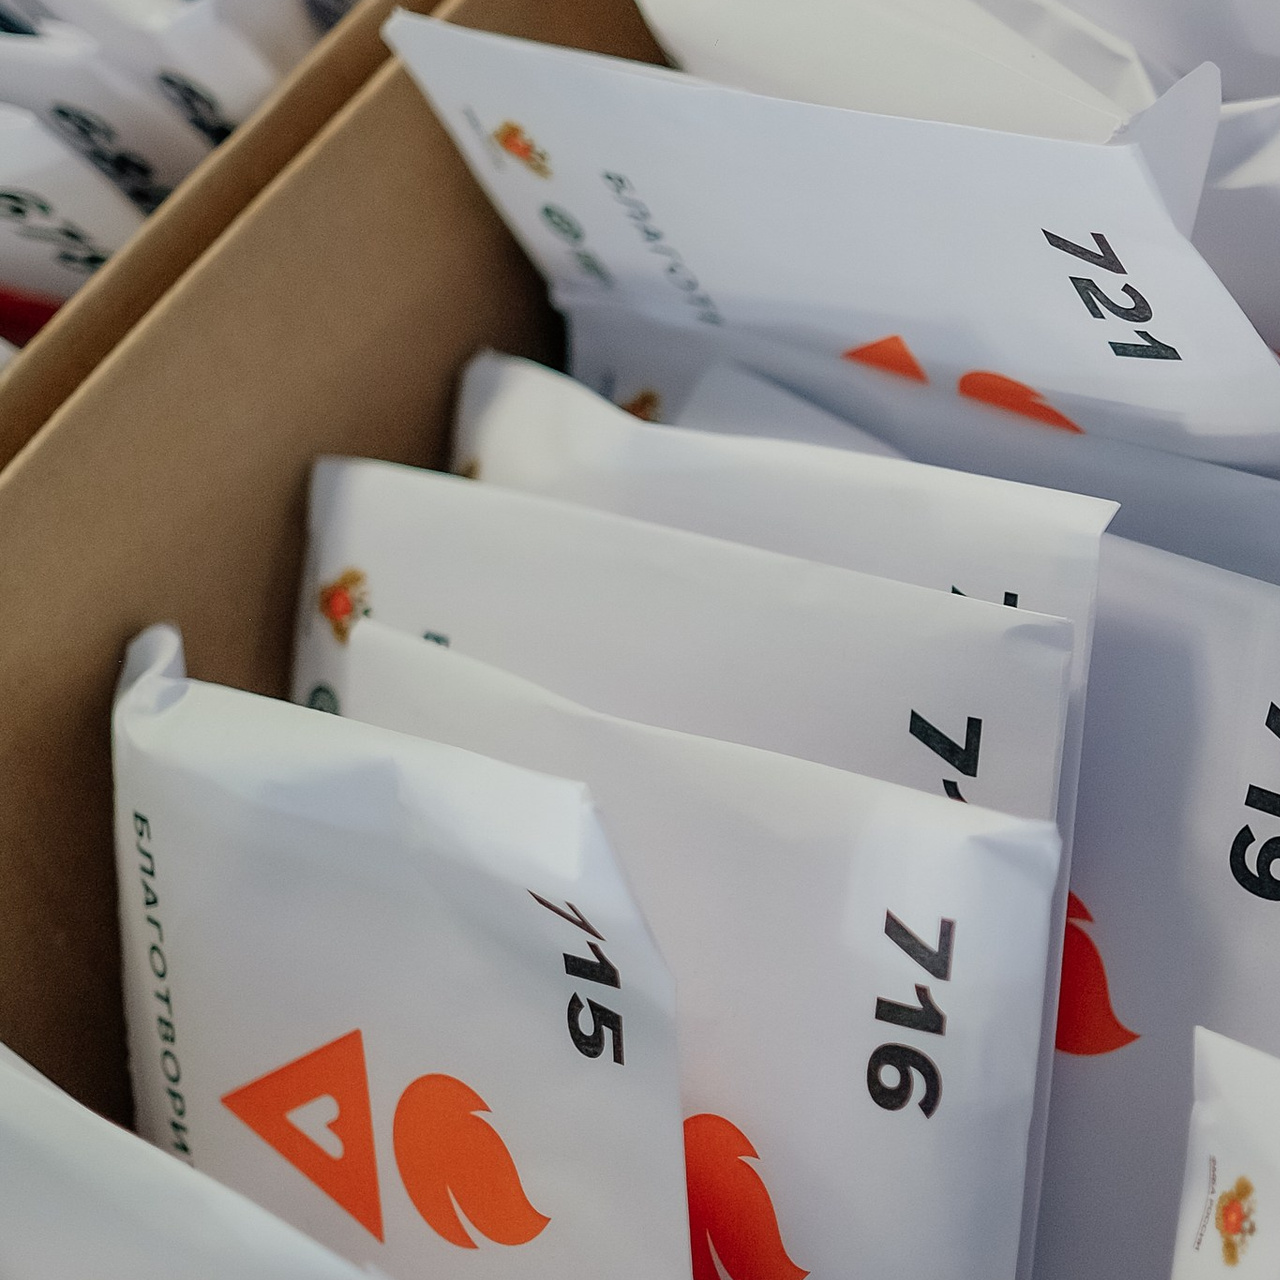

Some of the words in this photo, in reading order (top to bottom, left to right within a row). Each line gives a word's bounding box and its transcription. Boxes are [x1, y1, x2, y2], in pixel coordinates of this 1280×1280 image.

[1041, 228, 1182, 361] 721
[527, 888, 626, 1068] 715
[865, 908, 957, 1120] 716
